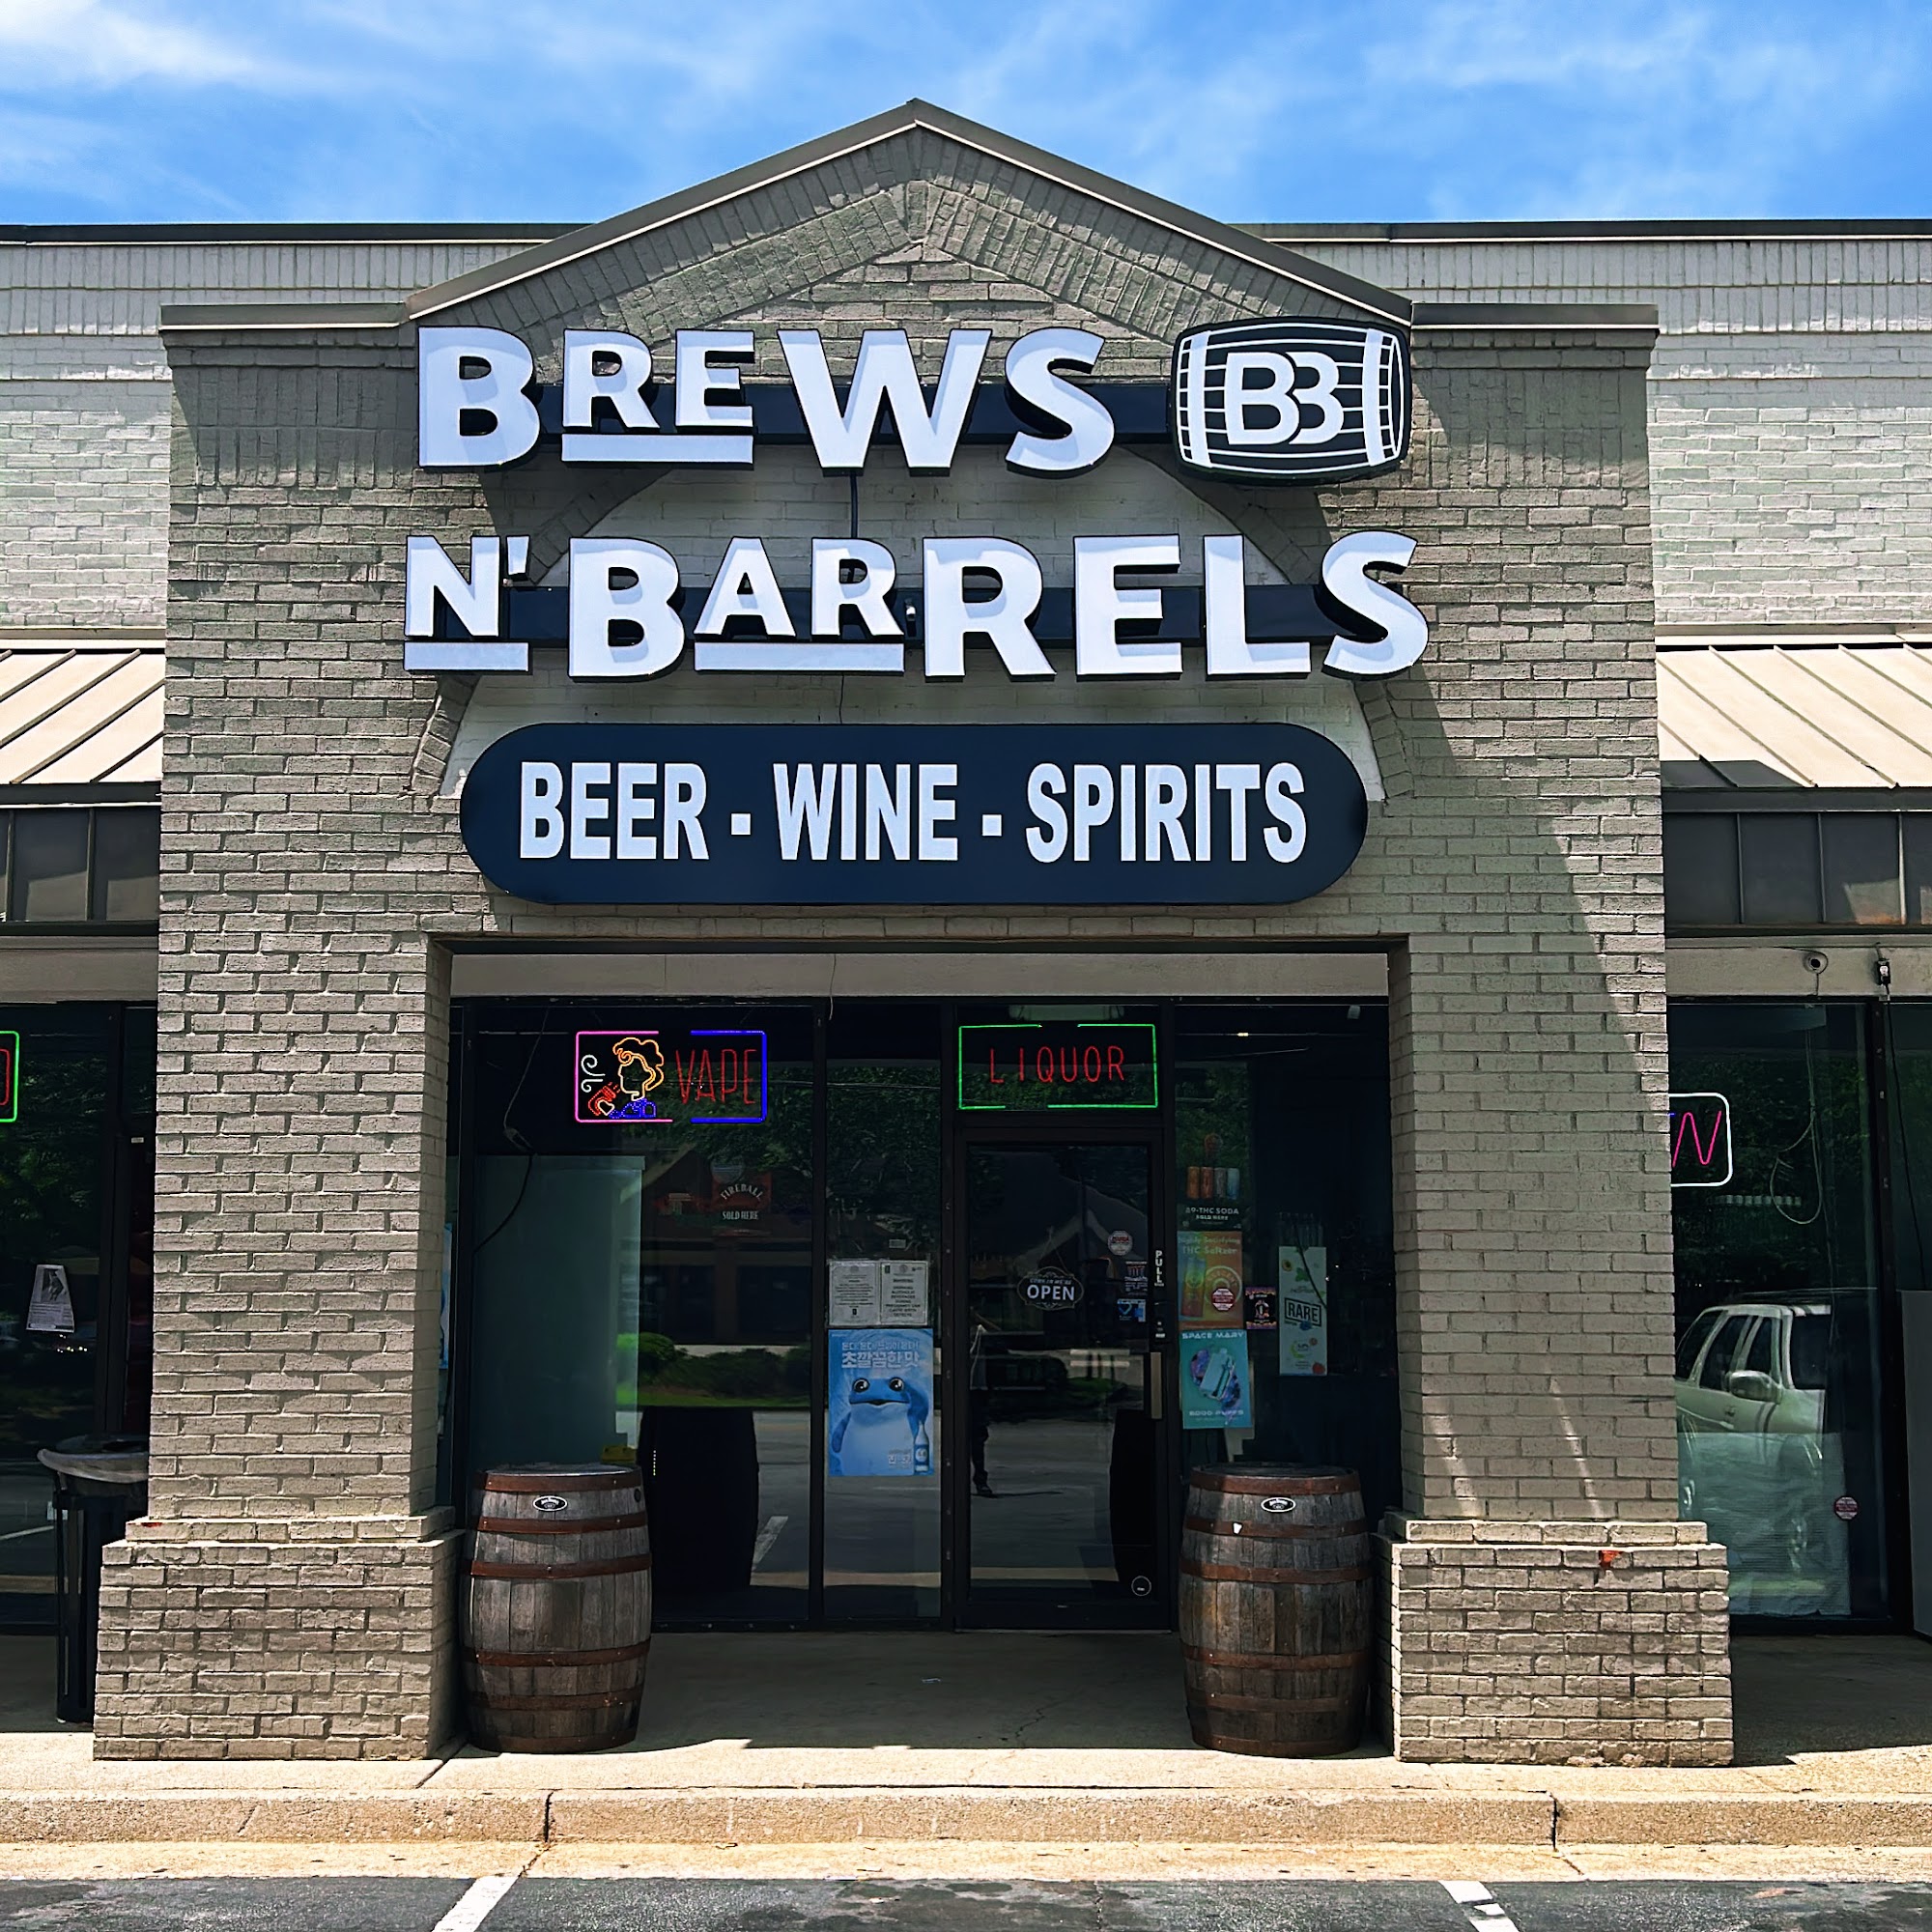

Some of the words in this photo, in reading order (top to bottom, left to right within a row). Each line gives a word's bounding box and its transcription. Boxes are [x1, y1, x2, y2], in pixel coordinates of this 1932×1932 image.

[417, 326, 1115, 471] BREWS
[568, 531, 1429, 677] BARRELS
[520, 761, 710, 860] BEER
[773, 763, 958, 861] WINE
[1025, 762, 1307, 863] SPIRITS
[675, 1049, 757, 1104] VAPE
[989, 1045, 1125, 1084] LIQUOR
[720, 1183, 764, 1201] FIREBALL
[722, 1210, 740, 1220] SOLD
[740, 1210, 759, 1220] HERE
[1154, 1250, 1163, 1284] PULL
[1027, 1284, 1075, 1301] OPEN
[1288, 1301, 1319, 1323] RARE
